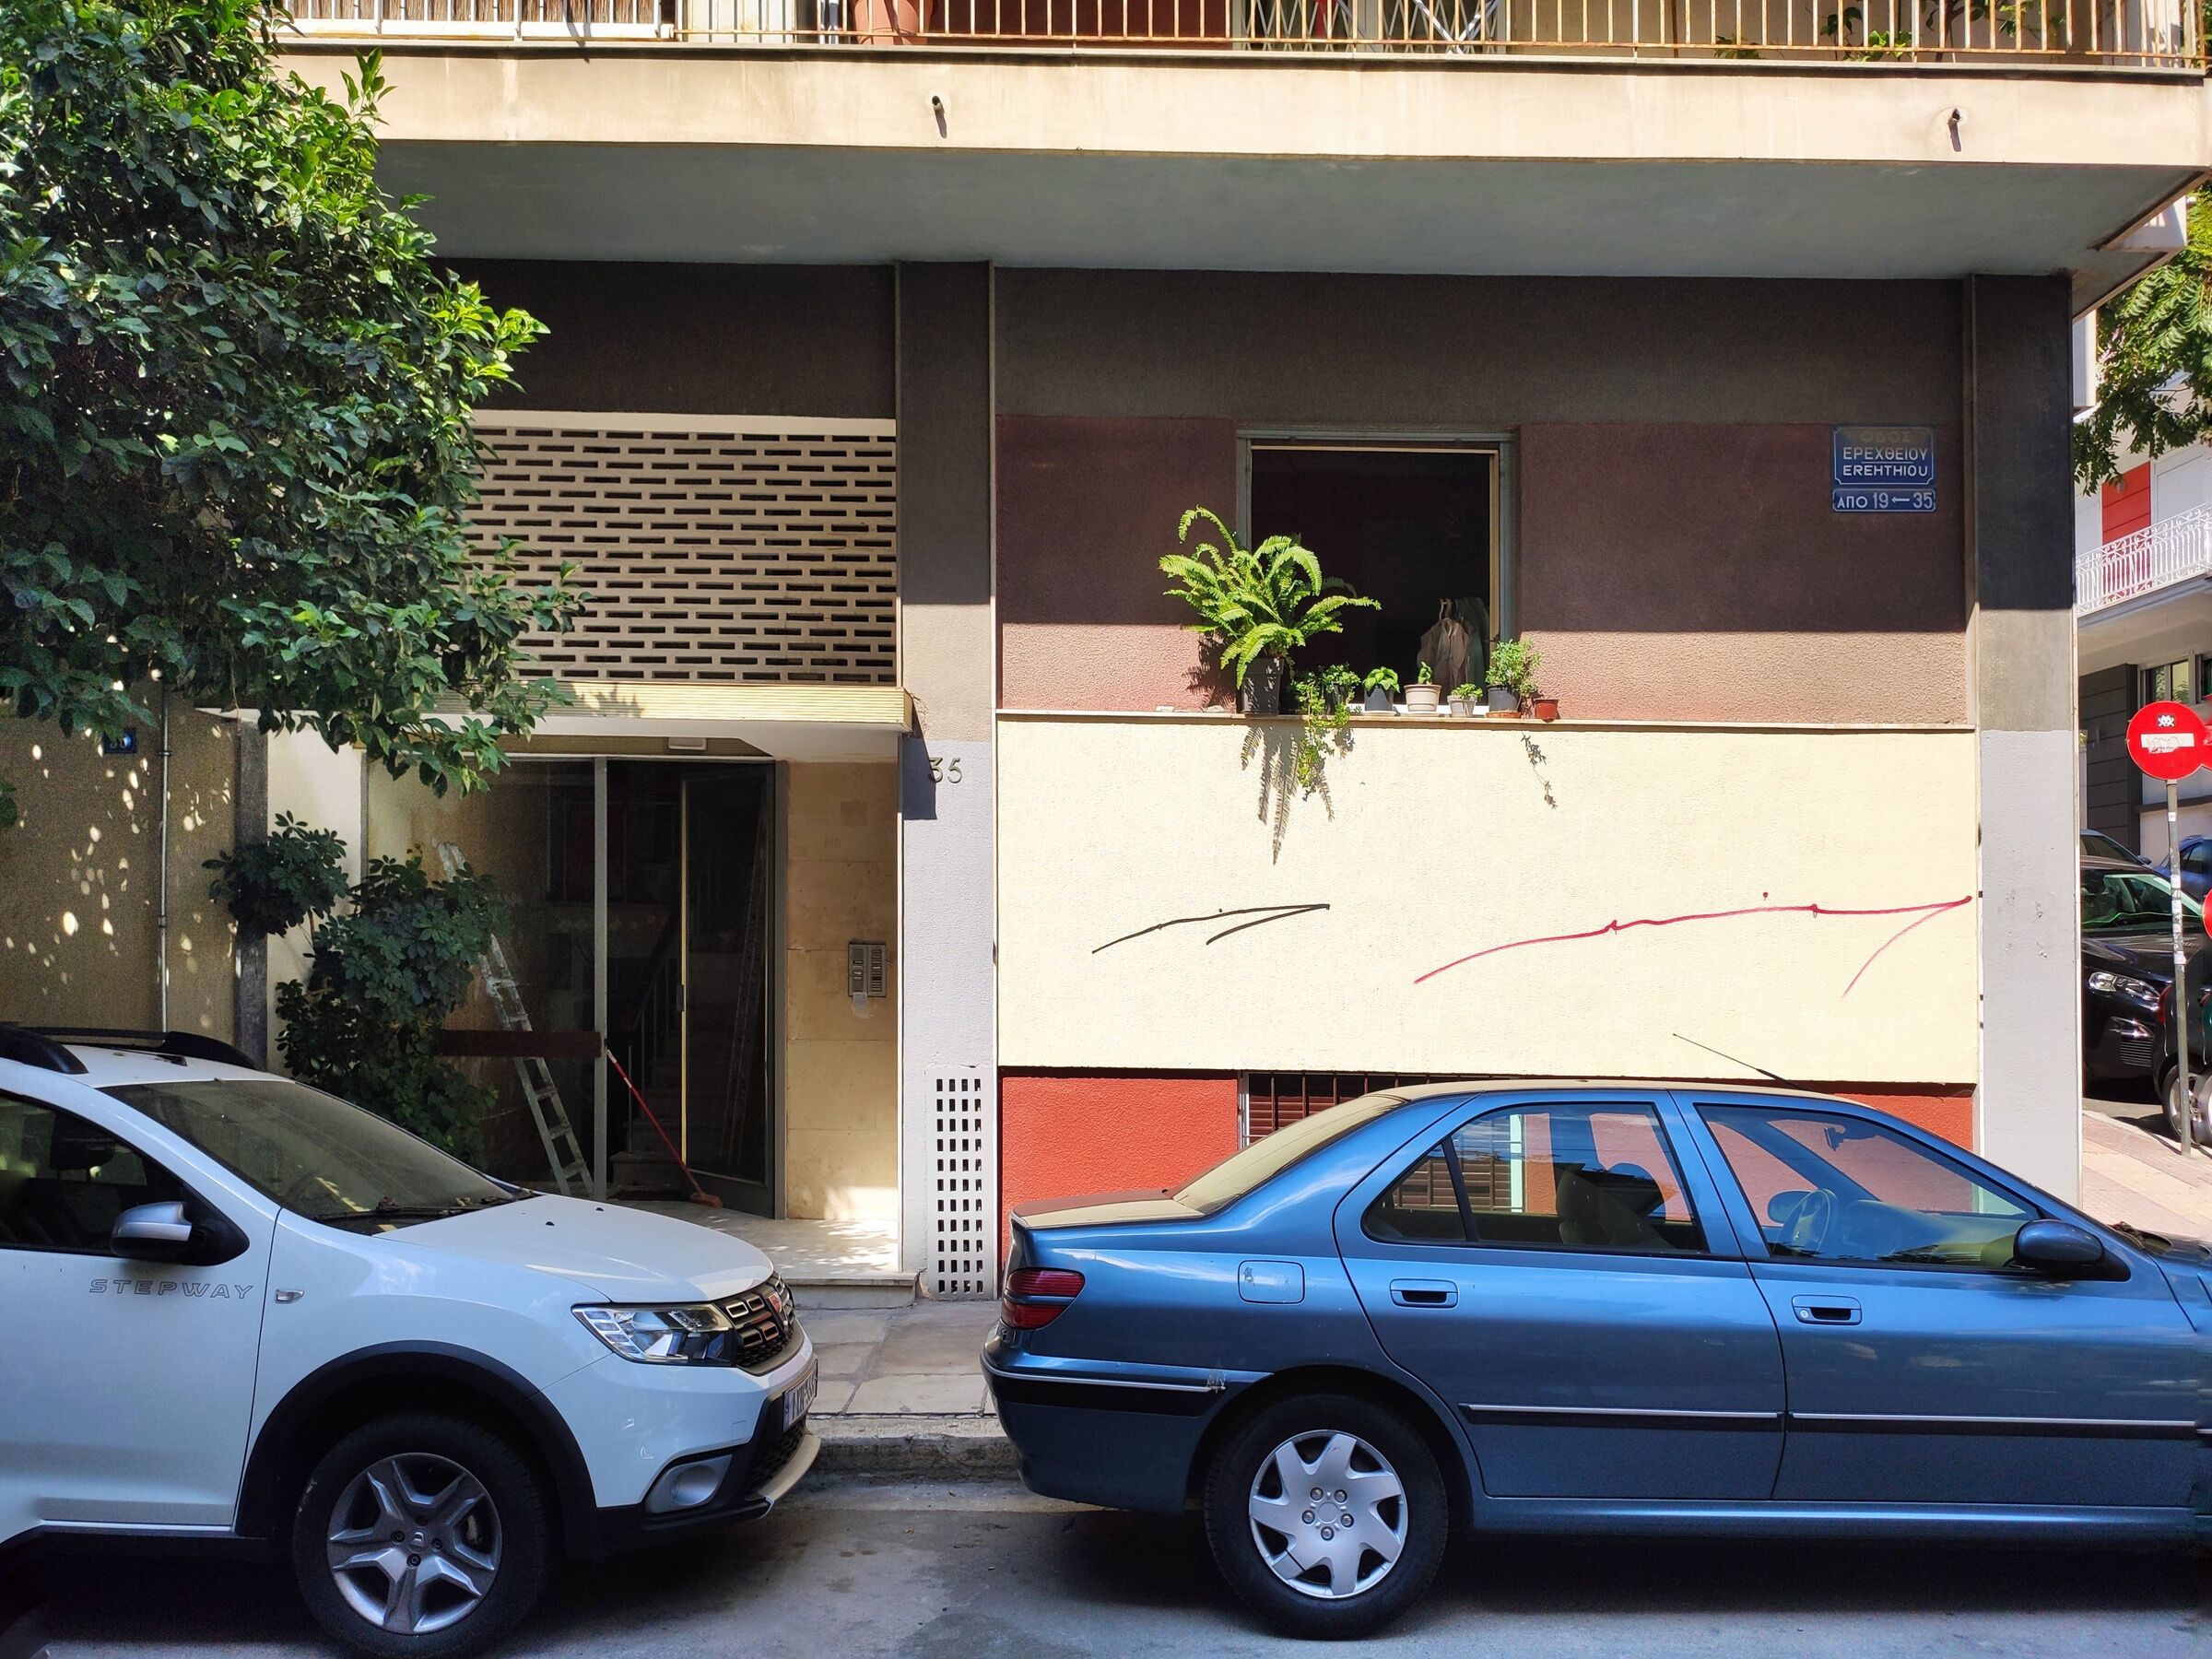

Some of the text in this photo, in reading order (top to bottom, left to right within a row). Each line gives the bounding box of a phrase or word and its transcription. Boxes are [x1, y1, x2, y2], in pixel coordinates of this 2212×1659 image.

[1861, 430, 1912, 443] ΟΔΟΣ
[1843, 447, 1928, 461] ΕΡΕΧΘΕΙΟΥ
[1843, 465, 1928, 477] EREHTHIOU
[1837, 492, 1933, 509] ΑΠΟ 19 35
[928, 757, 963, 784] 35
[89, 1278, 253, 1300] STEPWAY
